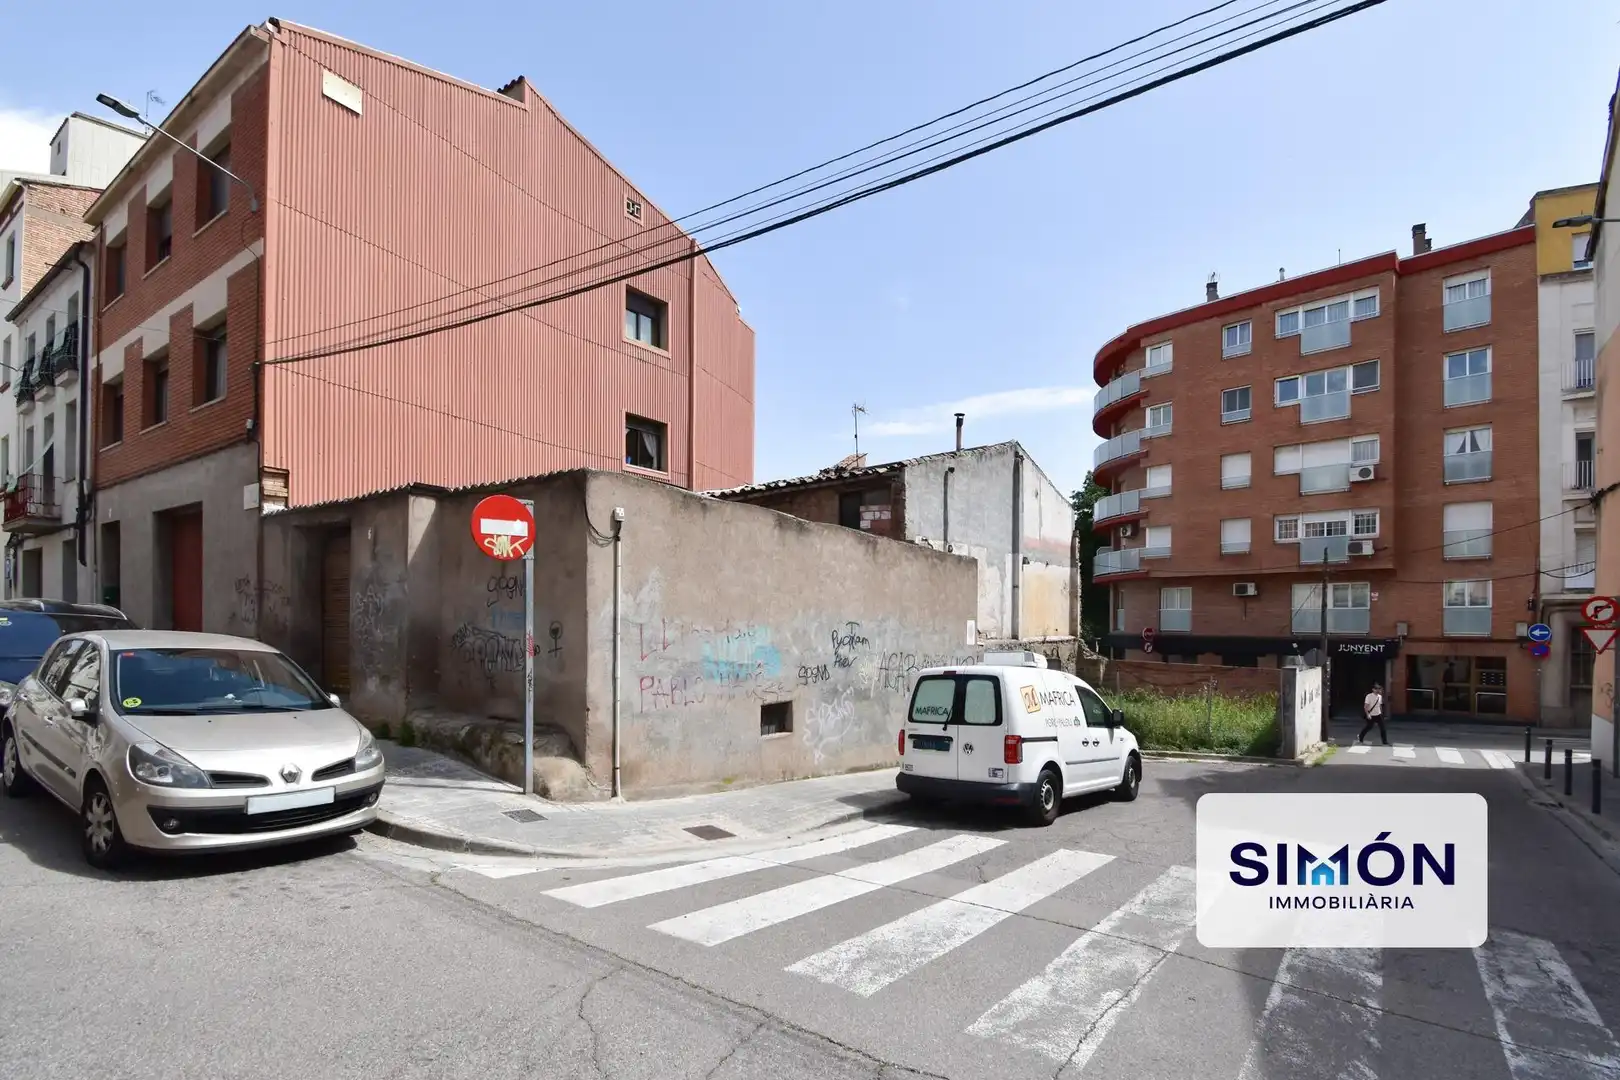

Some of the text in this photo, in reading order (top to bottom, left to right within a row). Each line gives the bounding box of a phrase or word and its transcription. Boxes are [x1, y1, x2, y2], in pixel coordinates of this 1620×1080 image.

[1338, 643, 1386, 653] JUNYENT
[1039, 690, 1077, 706] MAFRICA
[915, 705, 949, 717] MAFRICA
